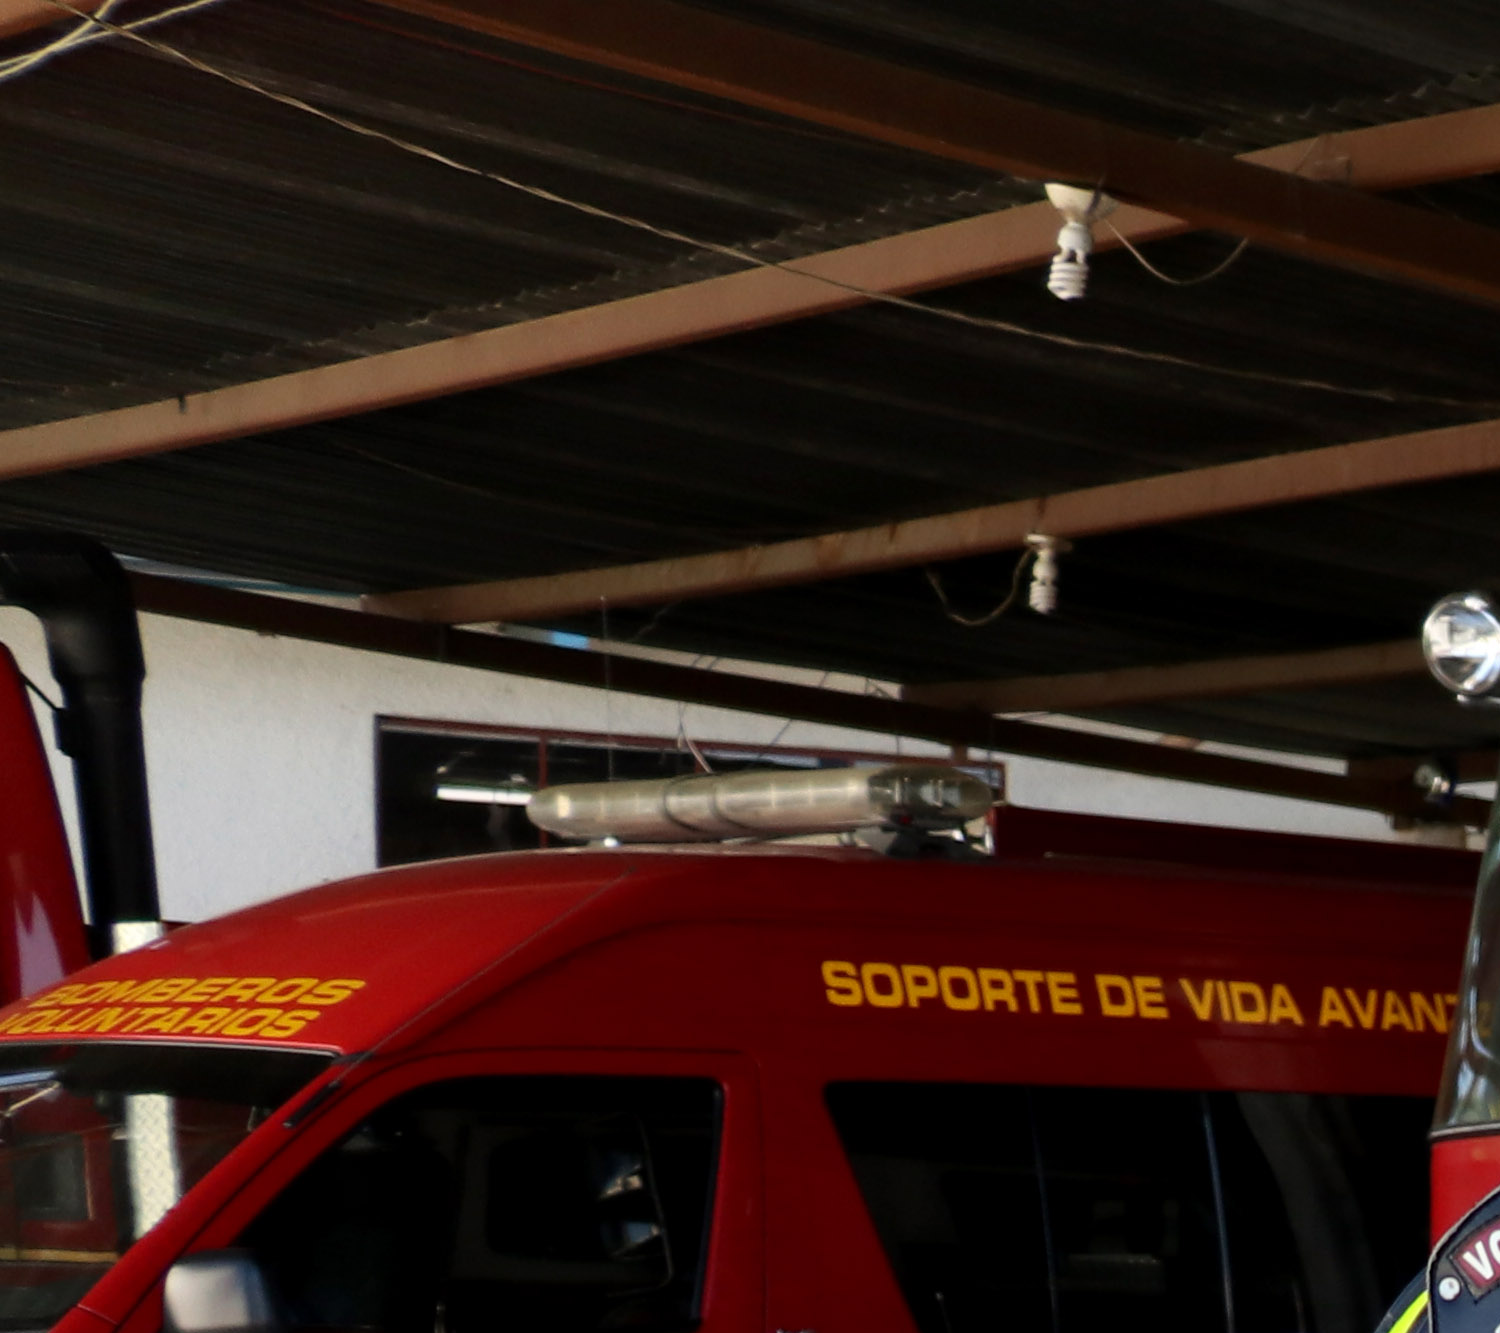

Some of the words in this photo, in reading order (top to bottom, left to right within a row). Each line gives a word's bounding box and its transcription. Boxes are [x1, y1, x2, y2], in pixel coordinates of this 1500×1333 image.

[27, 977, 366, 1009] BOMBEROS
[821, 960, 1083, 1015] SOPORTE
[1094, 973, 1169, 1019] DE
[1178, 977, 1303, 1026] VIDA
[0, 1006, 321, 1038] VOLUNTARIOS
